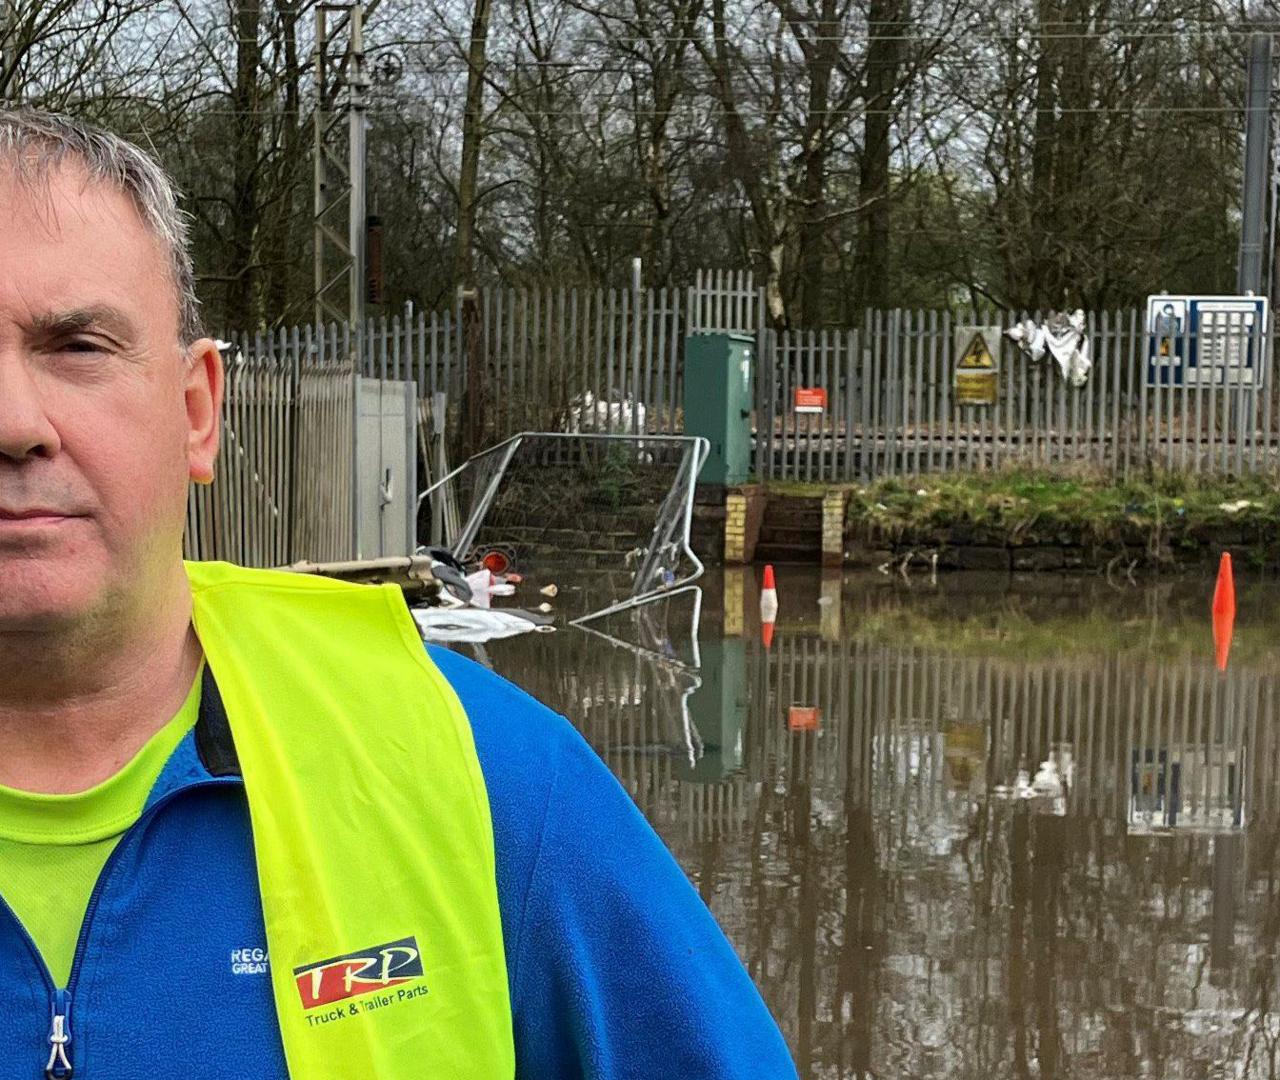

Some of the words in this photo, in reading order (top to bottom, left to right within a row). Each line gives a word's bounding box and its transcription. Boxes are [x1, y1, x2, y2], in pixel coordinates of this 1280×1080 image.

[232, 963, 268, 974] GREAT
[295, 946, 423, 1000] TRP
[305, 1006, 346, 1027] Truck
[349, 1003, 359, 1015] &
[360, 992, 395, 1012] Trailer
[397, 985, 429, 1002] Parts
